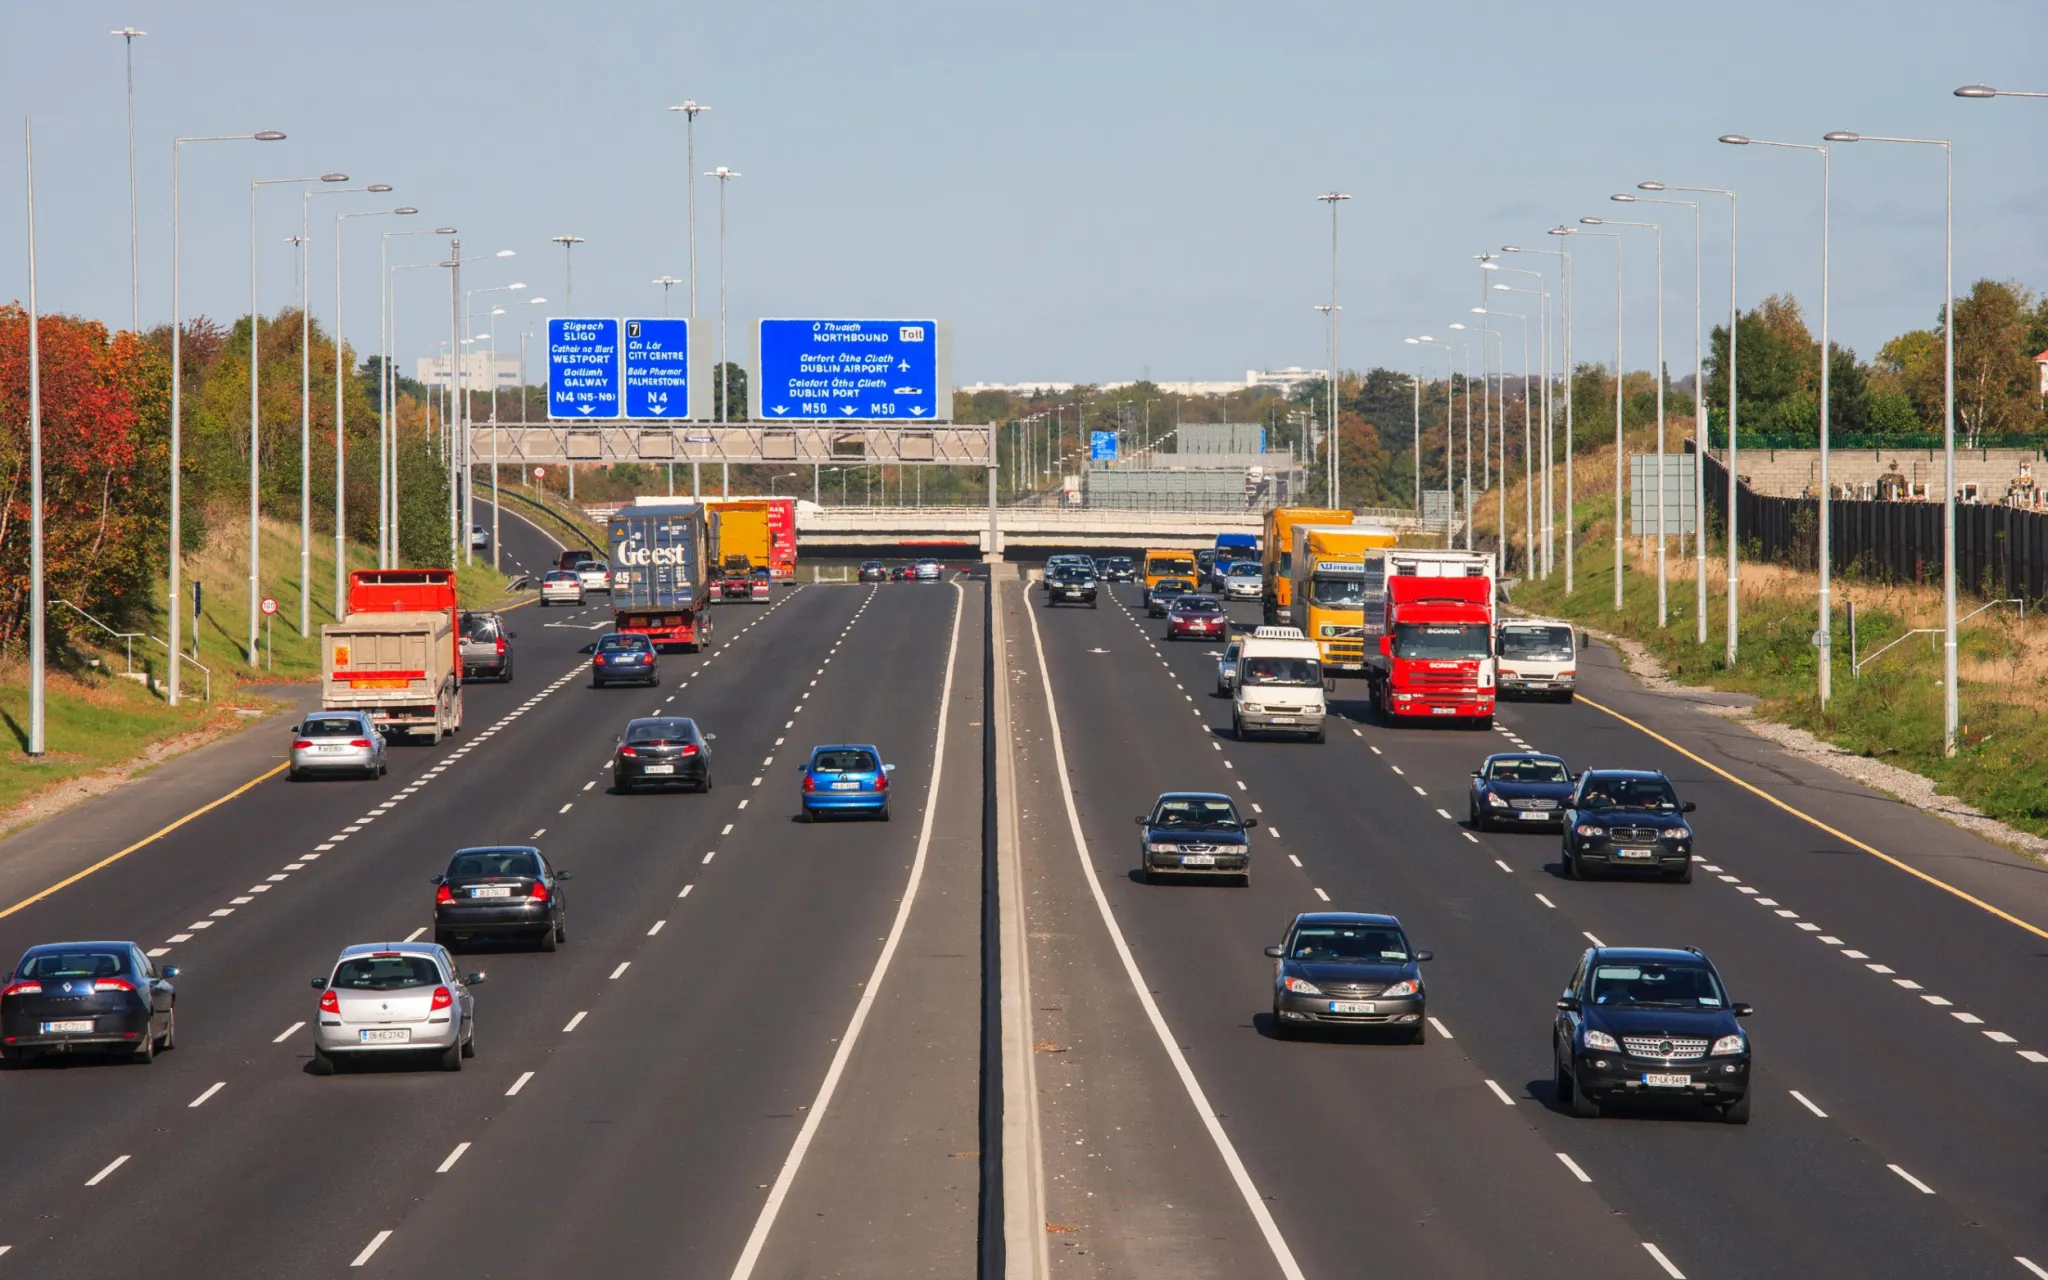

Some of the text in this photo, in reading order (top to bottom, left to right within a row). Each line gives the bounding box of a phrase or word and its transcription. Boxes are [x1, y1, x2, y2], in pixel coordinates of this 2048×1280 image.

[562, 321, 604, 331] Sligeach
[630, 323, 639, 336] 7
[824, 322, 861, 332] Thuaidh
[564, 332, 596, 341] SLIGO
[813, 333, 889, 342] NORTHBOUND
[901, 329, 923, 340] Toll
[551, 344, 614, 353] Cathair na Mart
[629, 341, 662, 350] An Lár
[552, 354, 610, 363] WESTPORT
[628, 351, 684, 360] CITY CENTRE
[800, 353, 835, 363] Aerfort
[864, 353, 894, 363] Cliath
[563, 368, 603, 377] Gaillimh
[627, 367, 648, 376] Baile
[800, 364, 889, 373] DUBLIN AIRPORT
[564, 378, 608, 387] GALWAY
[628, 377, 685, 386] PALMERSTOWN
[788, 378, 828, 388] Calafort
[857, 378, 887, 388] Cliath
[556, 391, 574, 403] N4
[647, 391, 668, 403] N4
[789, 389, 860, 398] DUBLIN PORT
[802, 403, 828, 414] M50
[871, 403, 895, 414] M50
[617, 539, 686, 566] Geest
[615, 571, 630, 584] 45
[1426, 627, 1461, 635] SCANIA
